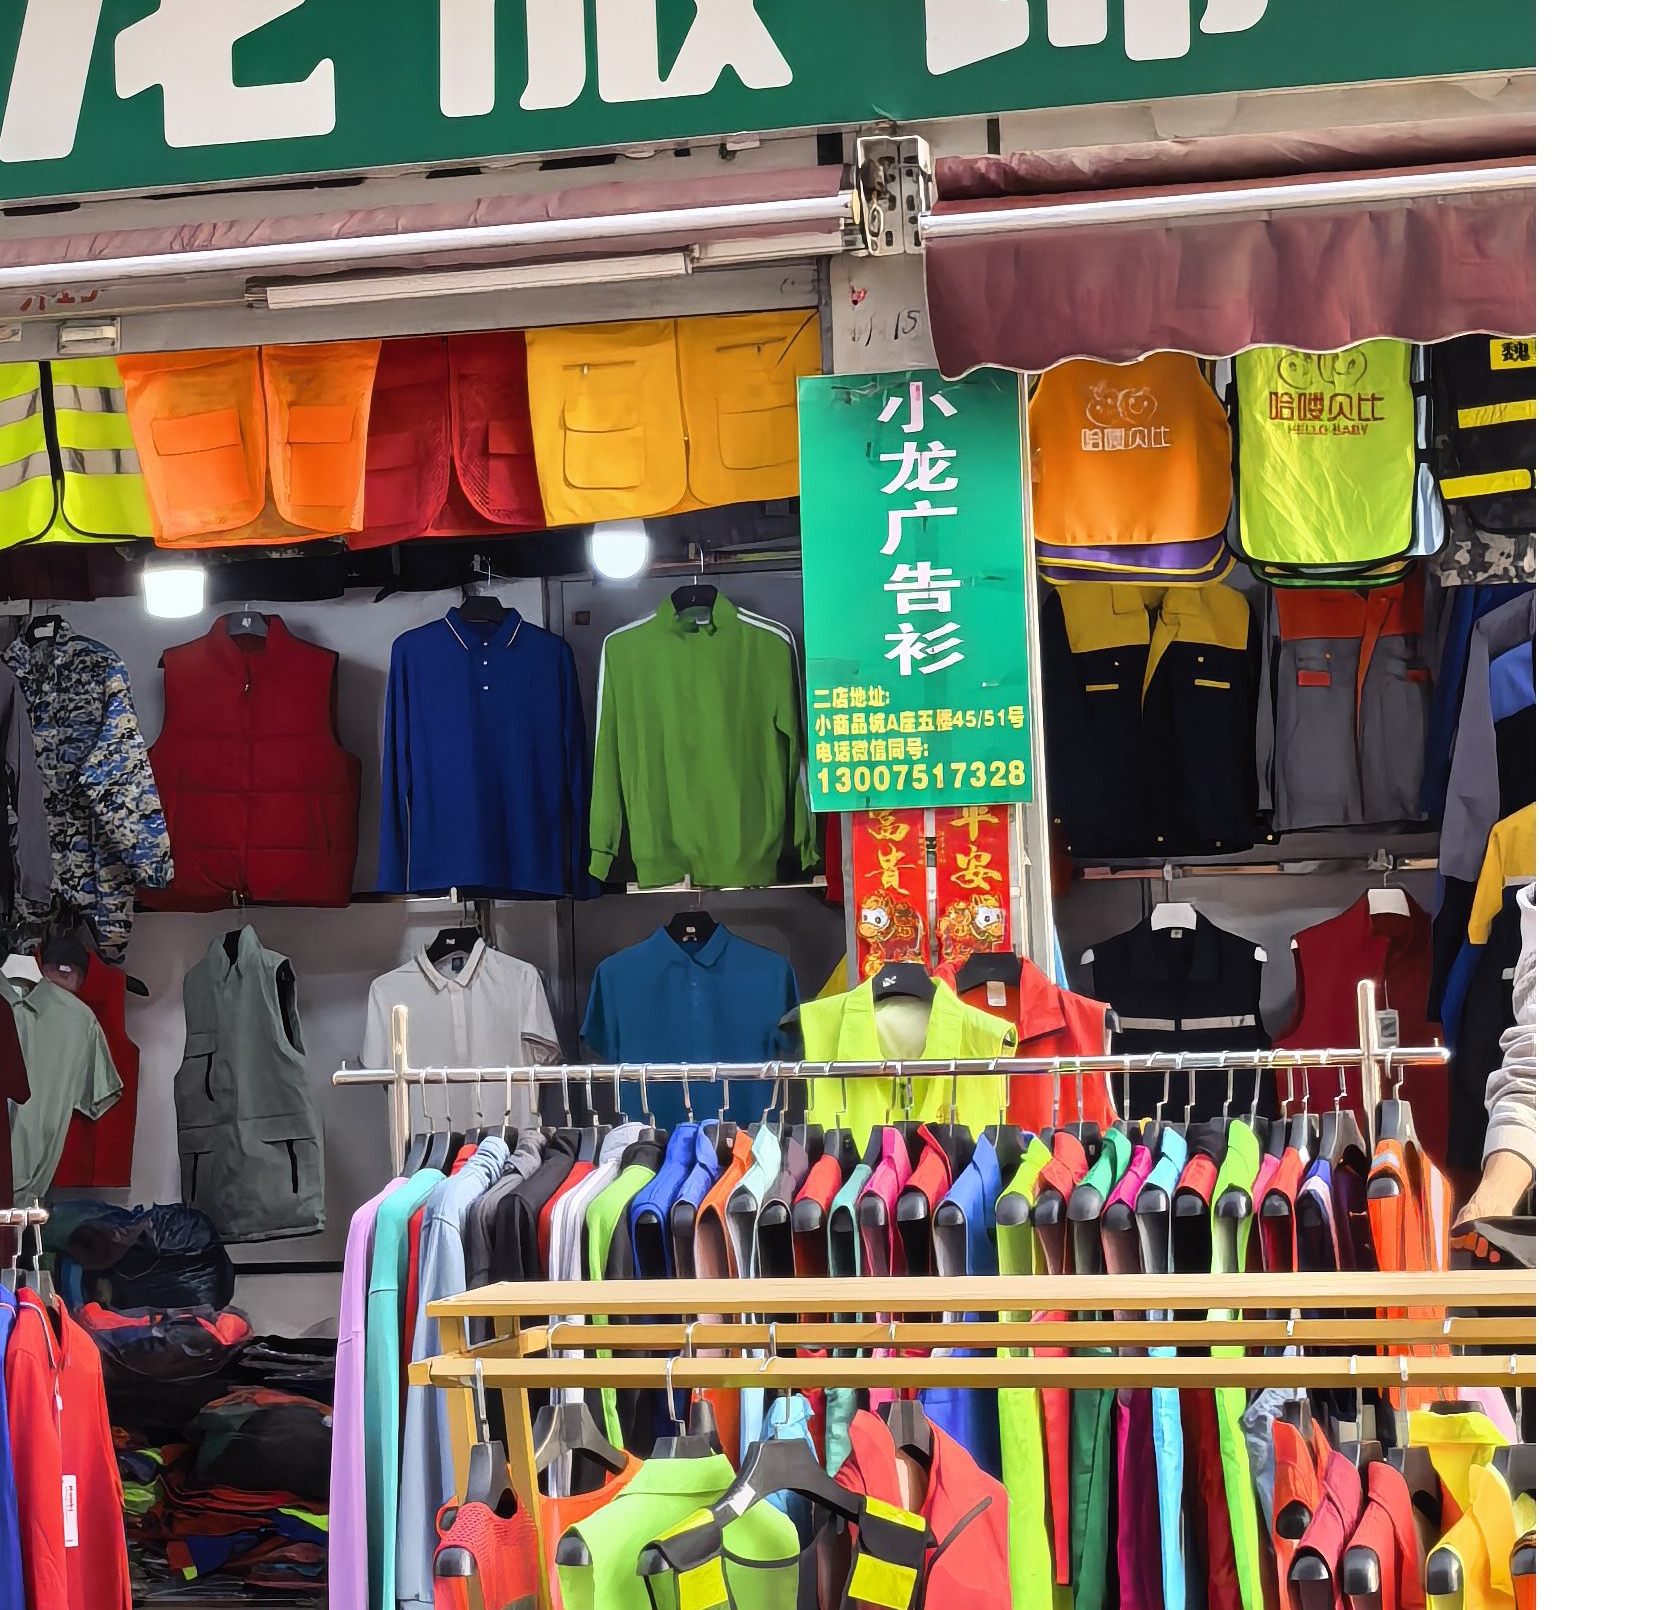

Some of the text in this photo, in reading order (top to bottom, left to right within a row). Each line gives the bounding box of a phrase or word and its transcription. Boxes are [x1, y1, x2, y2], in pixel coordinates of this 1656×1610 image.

[877, 381, 965, 676] 小龙广告衫
[817, 759, 1026, 794] 13007517328
